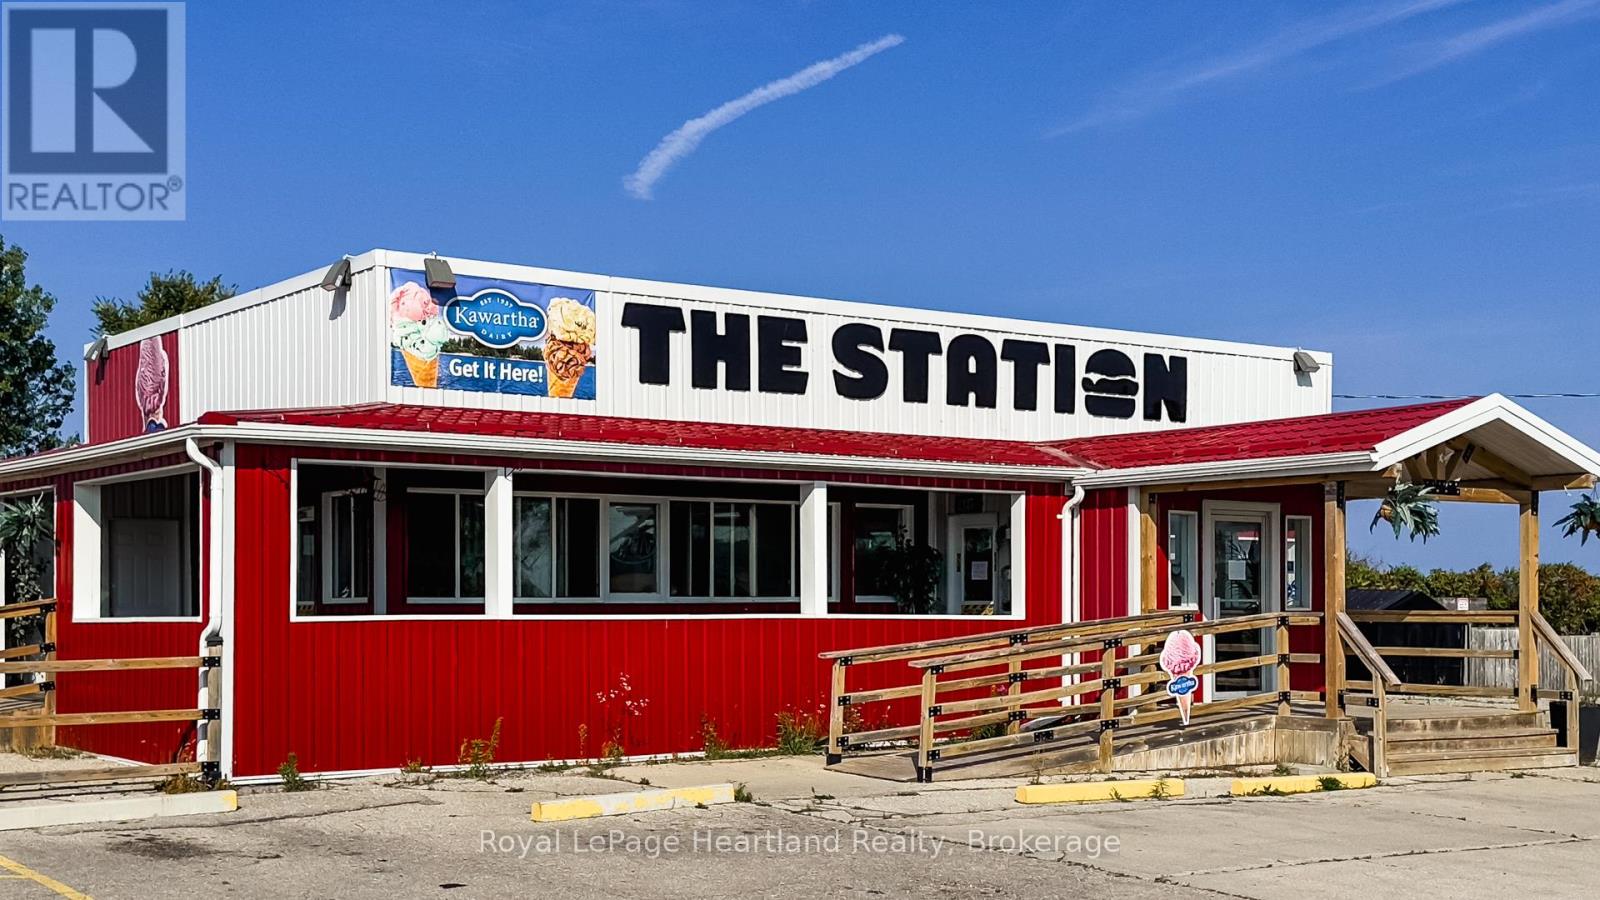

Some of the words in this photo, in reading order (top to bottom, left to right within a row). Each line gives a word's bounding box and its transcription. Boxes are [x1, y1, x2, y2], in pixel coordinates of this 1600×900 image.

[454, 306, 539, 329] Kawartha
[480, 328, 513, 340] DAIRY
[449, 359, 480, 378] Get
[484, 361, 496, 379] It
[500, 362, 543, 382] Here!
[621, 302, 809, 395] THE
[831, 322, 1188, 423] STATION
